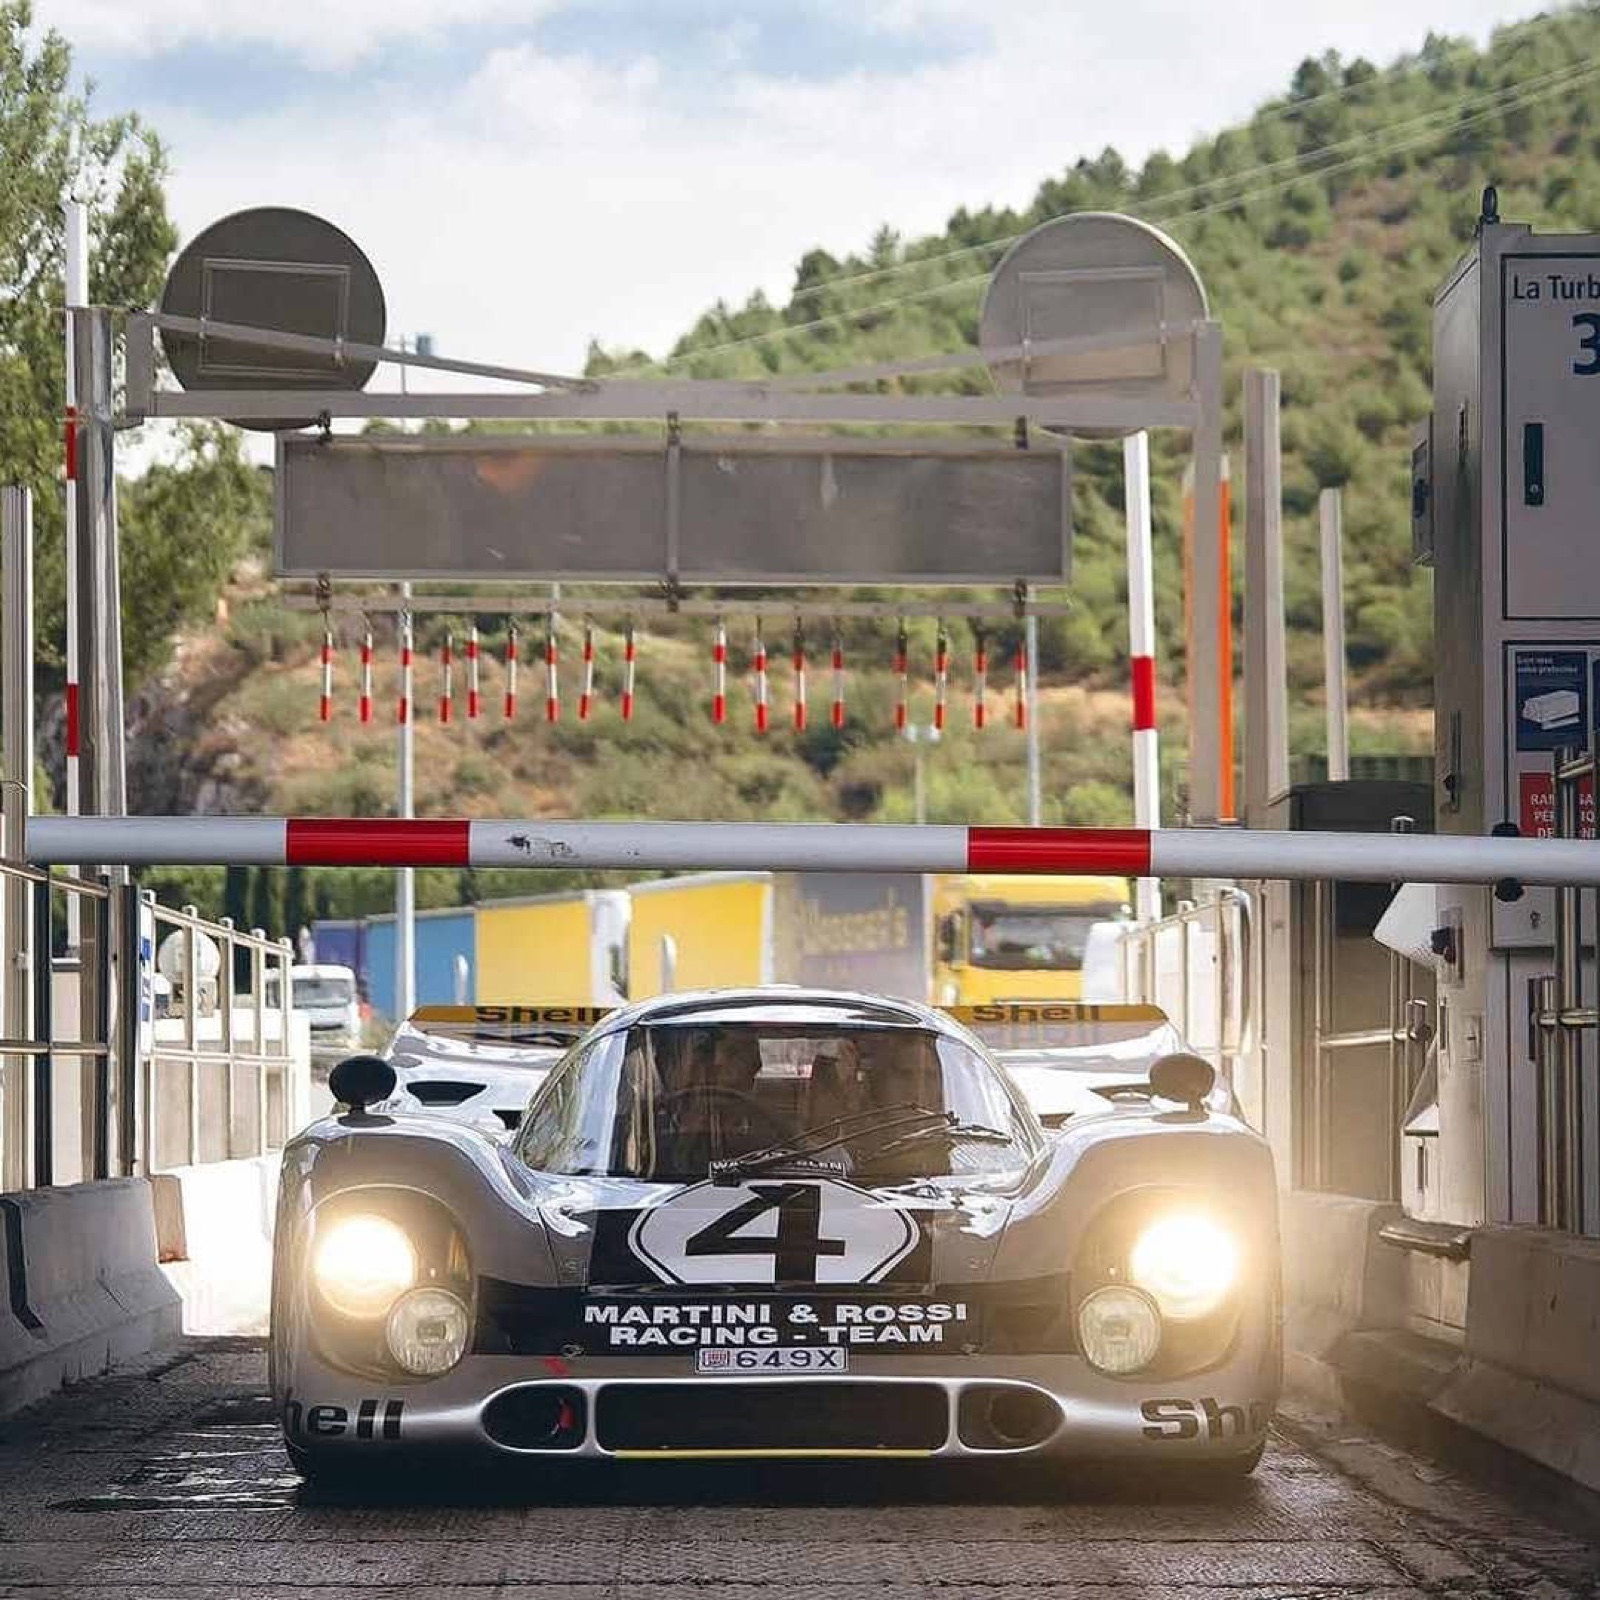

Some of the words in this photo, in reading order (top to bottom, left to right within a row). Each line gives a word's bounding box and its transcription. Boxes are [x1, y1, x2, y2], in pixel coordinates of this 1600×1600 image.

[1513, 274, 1540, 300] La
[1572, 312, 1600, 376] 3
[973, 1005, 1100, 1022] Shell
[685, 1183, 846, 1284] 4
[584, 1304, 770, 1324] MARTINI
[788, 1304, 819, 1323] &
[836, 1303, 967, 1322] ROSSI
[609, 1326, 779, 1346] RACING
[819, 1325, 943, 1343] TEAM
[736, 1350, 839, 1368] 649X
